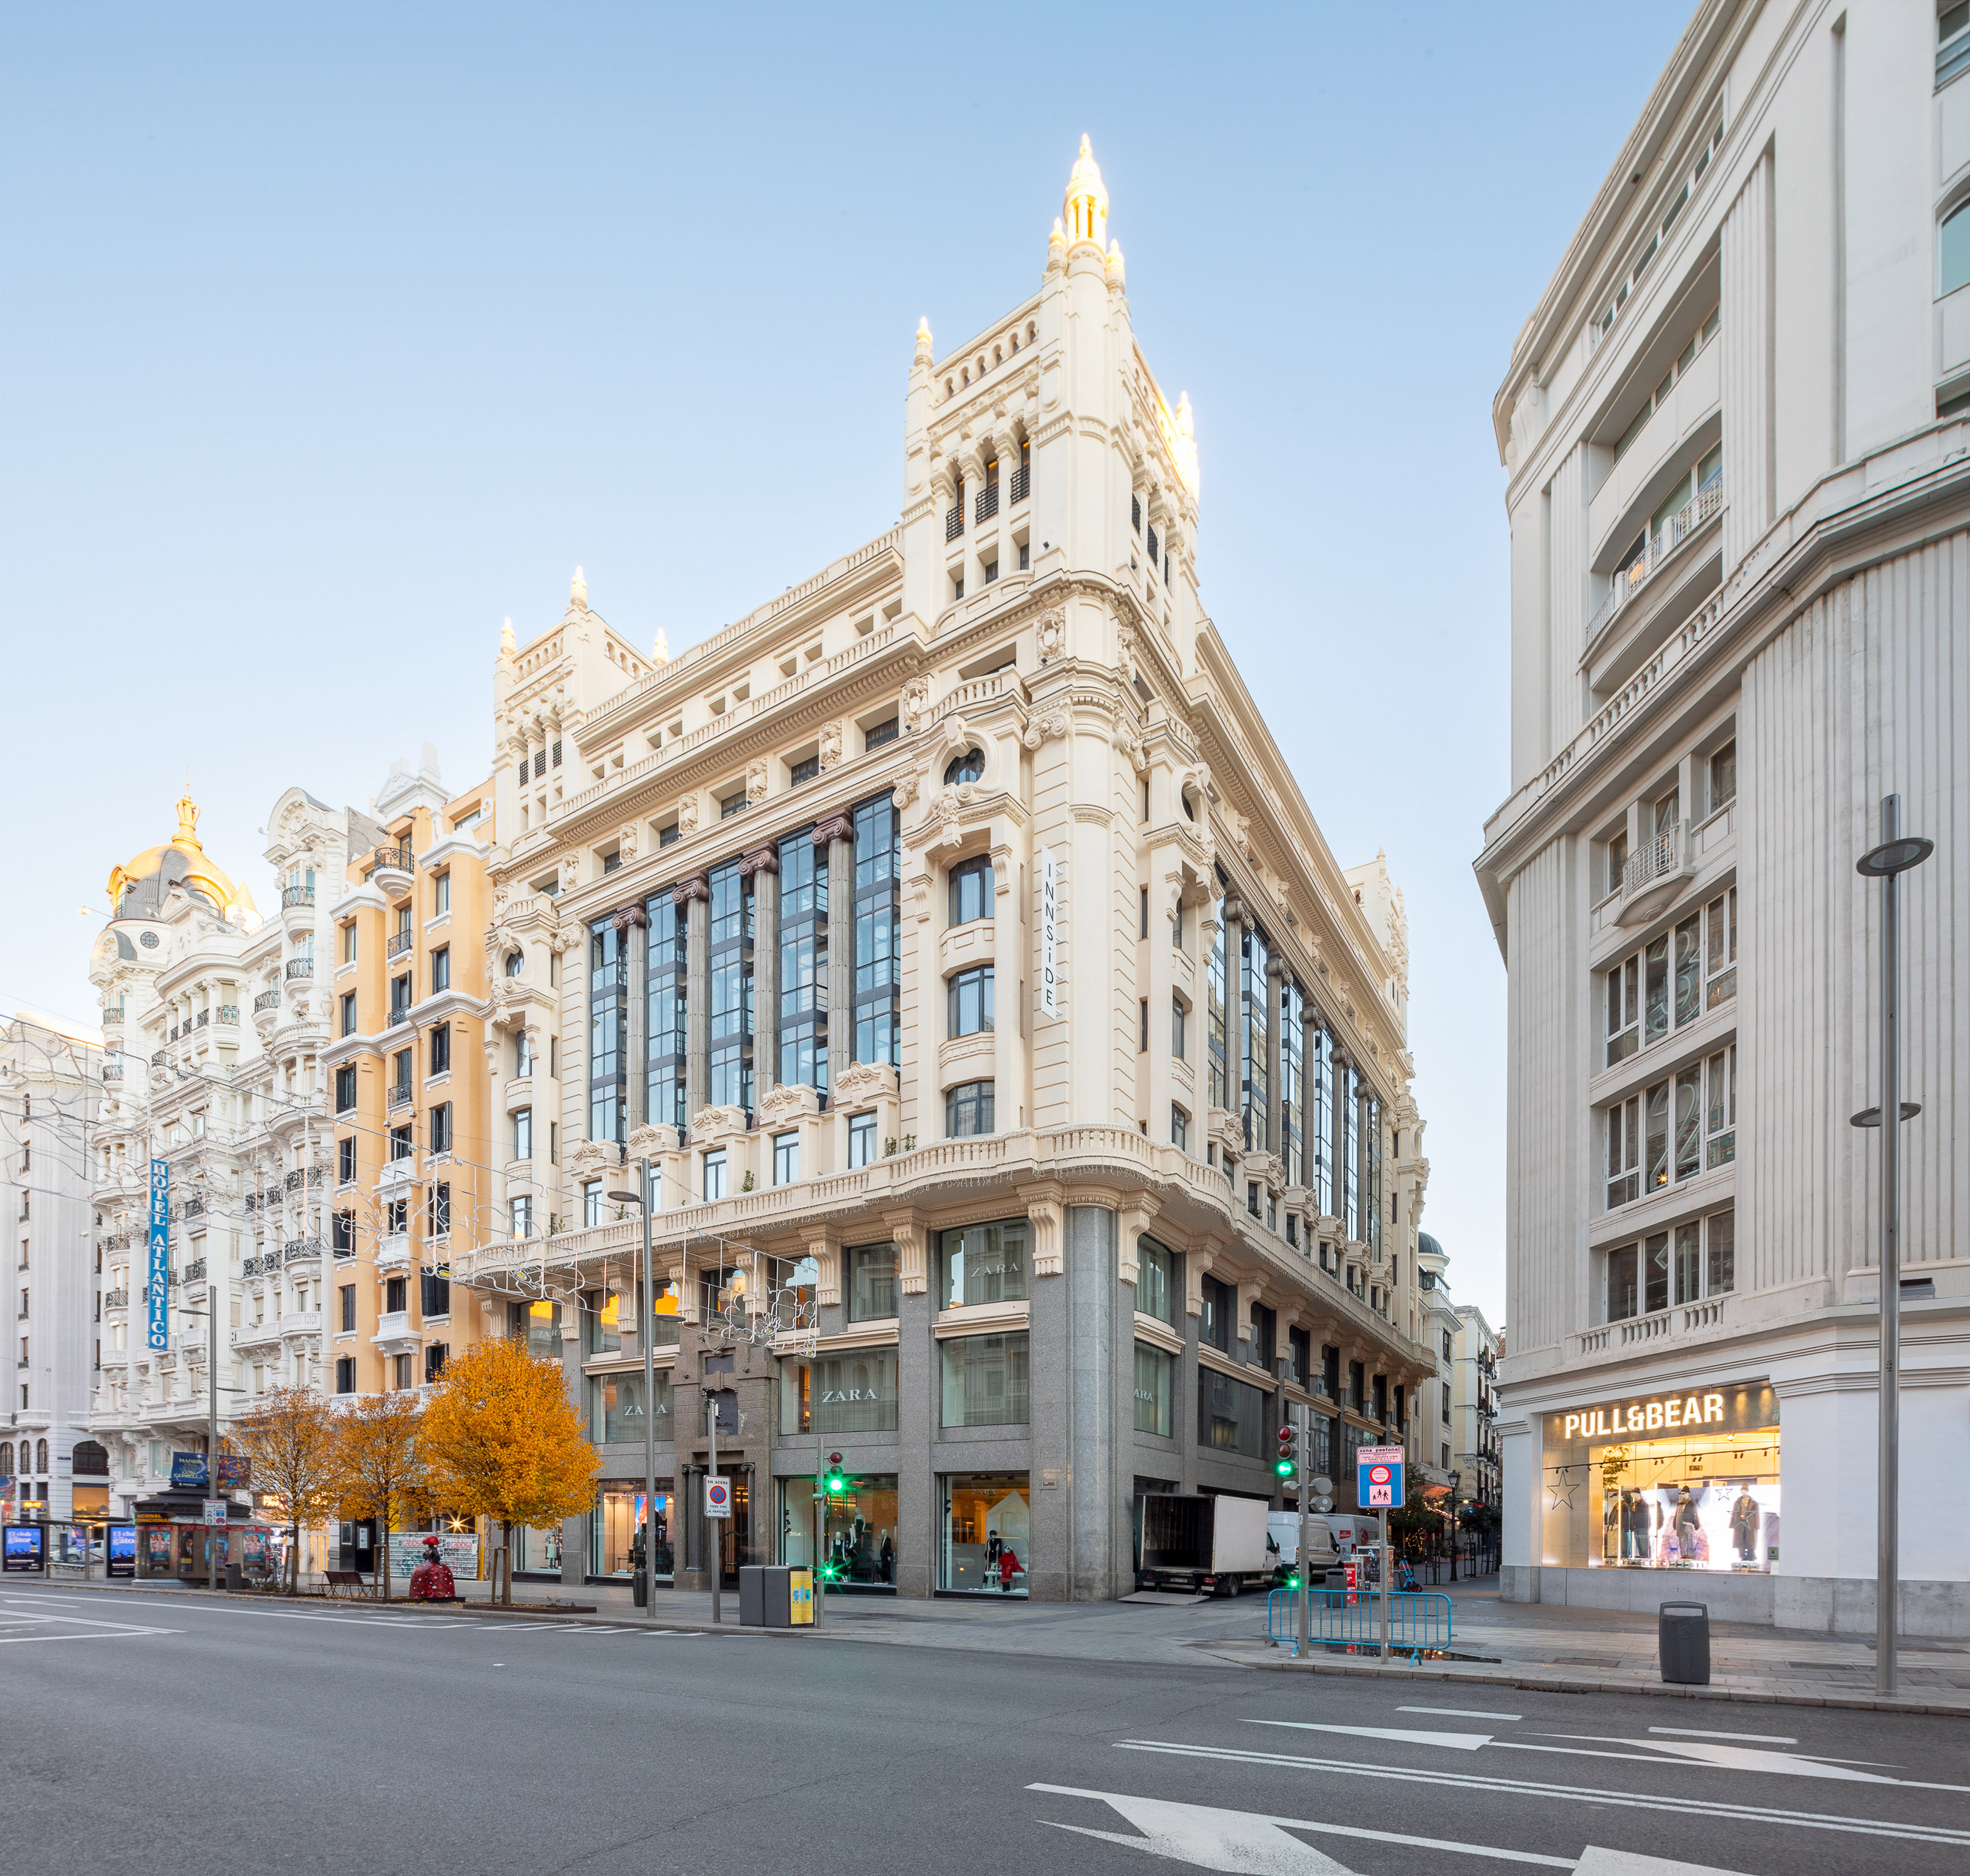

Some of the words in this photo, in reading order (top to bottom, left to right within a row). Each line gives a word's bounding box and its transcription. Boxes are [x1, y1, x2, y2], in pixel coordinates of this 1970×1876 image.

[153, 1164, 167, 1226] HOTEL
[971, 1262, 1019, 1277] ZARA
[151, 1233, 165, 1347] ATLANTICO
[822, 1387, 880, 1403] ZARA
[1134, 1387, 1153, 1401] ARA
[624, 1403, 668, 1416] ZAA
[1565, 1394, 1724, 1439] PULL&BEAR
[450, 1540, 472, 1548] cabbsa
